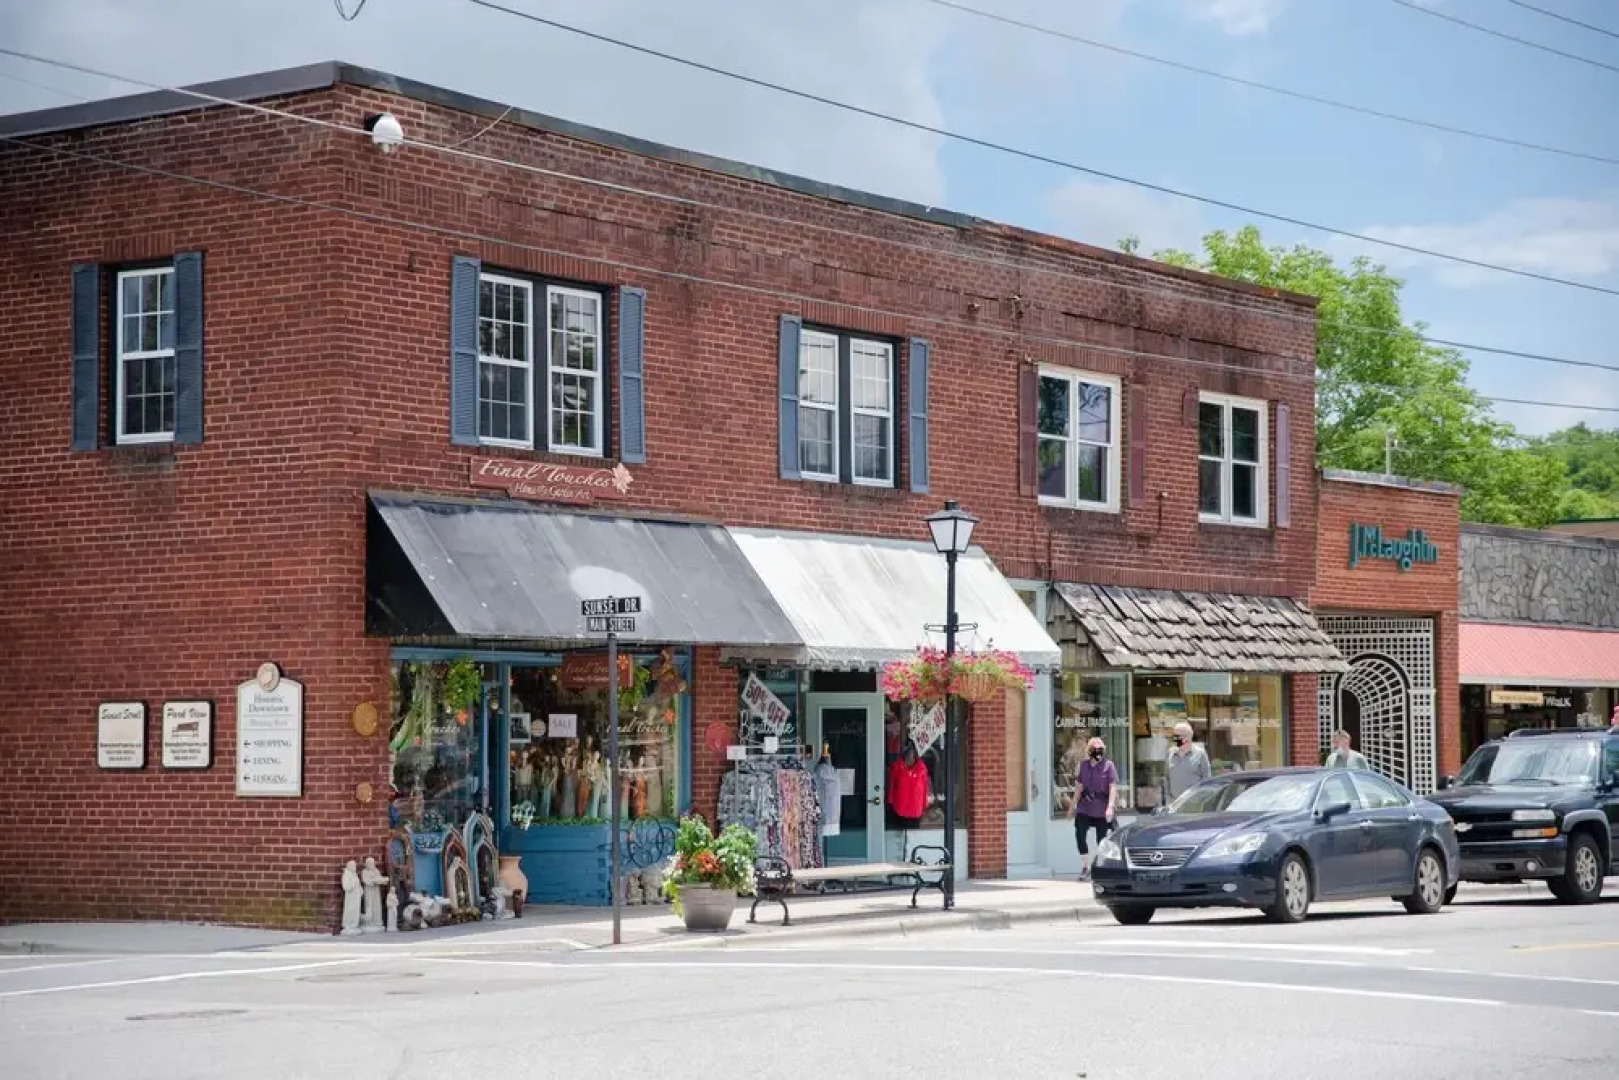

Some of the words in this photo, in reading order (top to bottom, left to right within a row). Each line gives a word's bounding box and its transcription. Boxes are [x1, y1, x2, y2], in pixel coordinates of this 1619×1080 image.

[479, 459, 540, 480] Final
[542, 463, 612, 488] Touches
[583, 599, 619, 614] SUNSET
[609, 617, 634, 631] STREET
[745, 680, 769, 713] 50%
[767, 700, 787, 724] OFF
